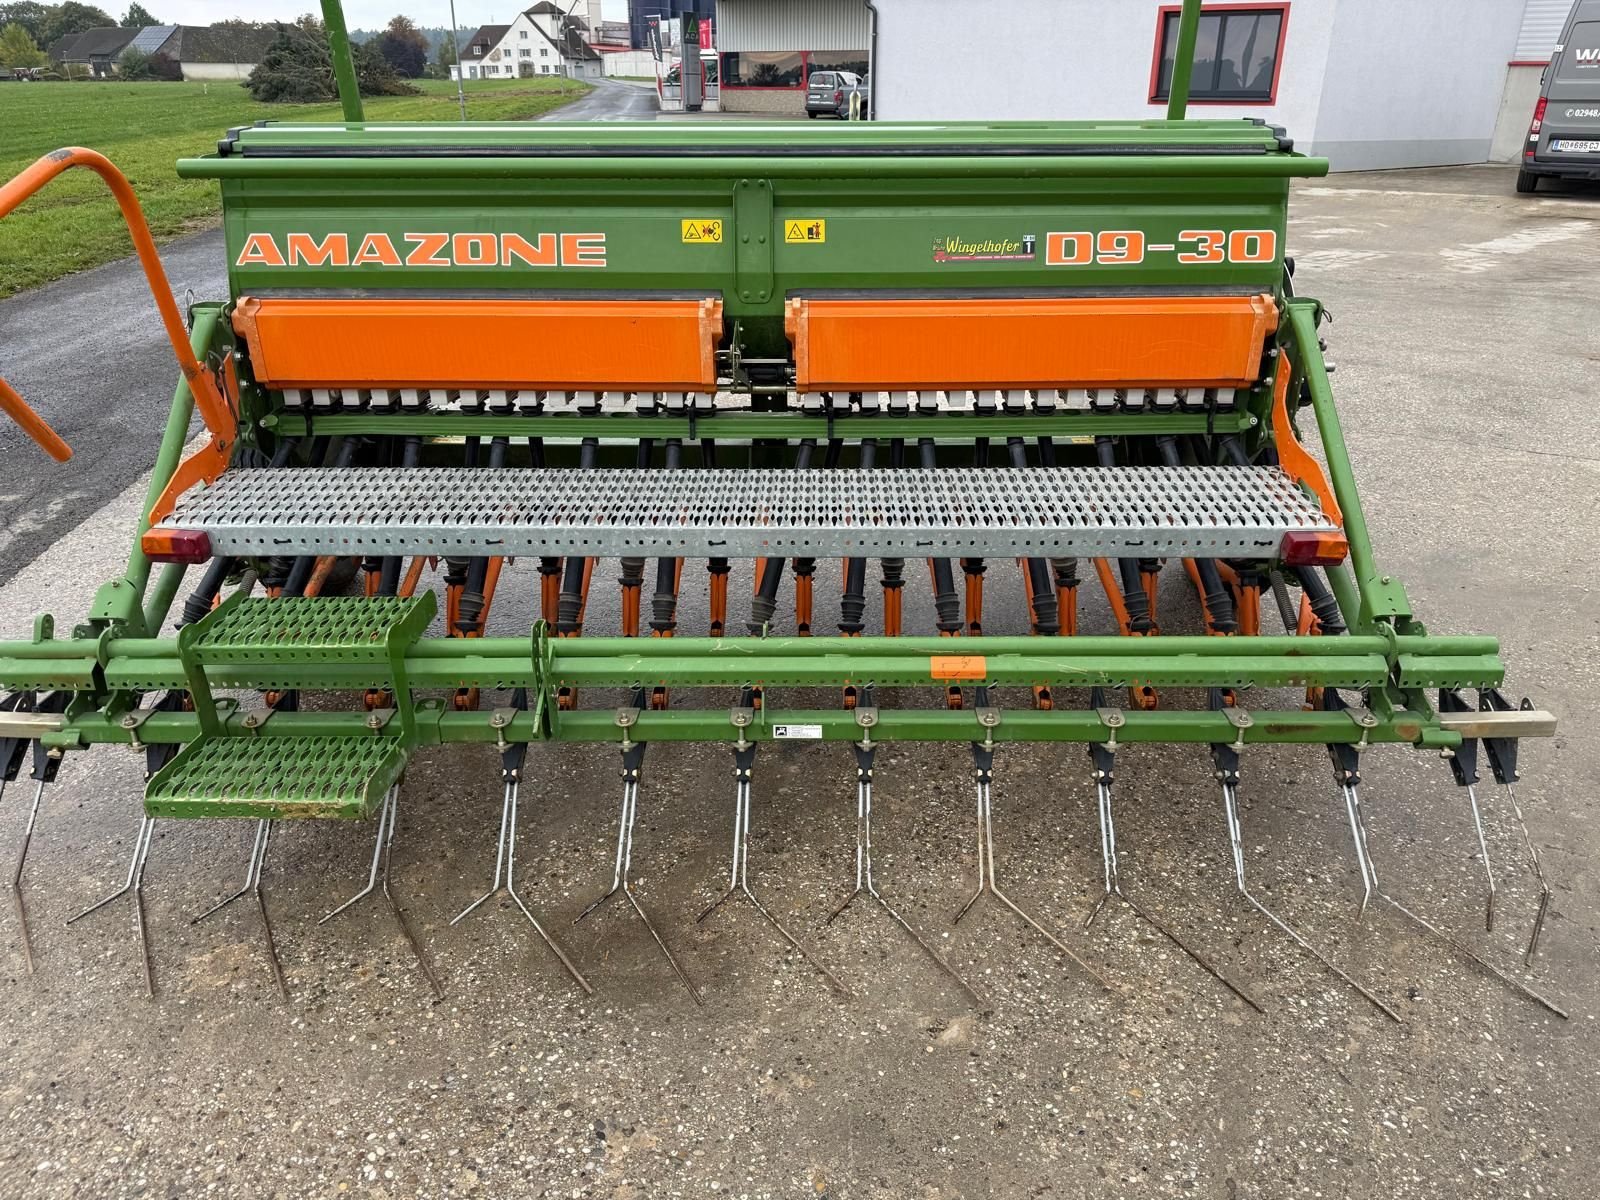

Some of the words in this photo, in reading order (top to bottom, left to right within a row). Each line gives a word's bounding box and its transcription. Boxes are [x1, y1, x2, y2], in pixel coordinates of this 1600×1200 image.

[1575, 48, 1600, 60] W
[236, 232, 607, 267] AMAZONE
[946, 236, 1020, 255] Wingelhofer
[1045, 229, 1277, 266] D9-30
